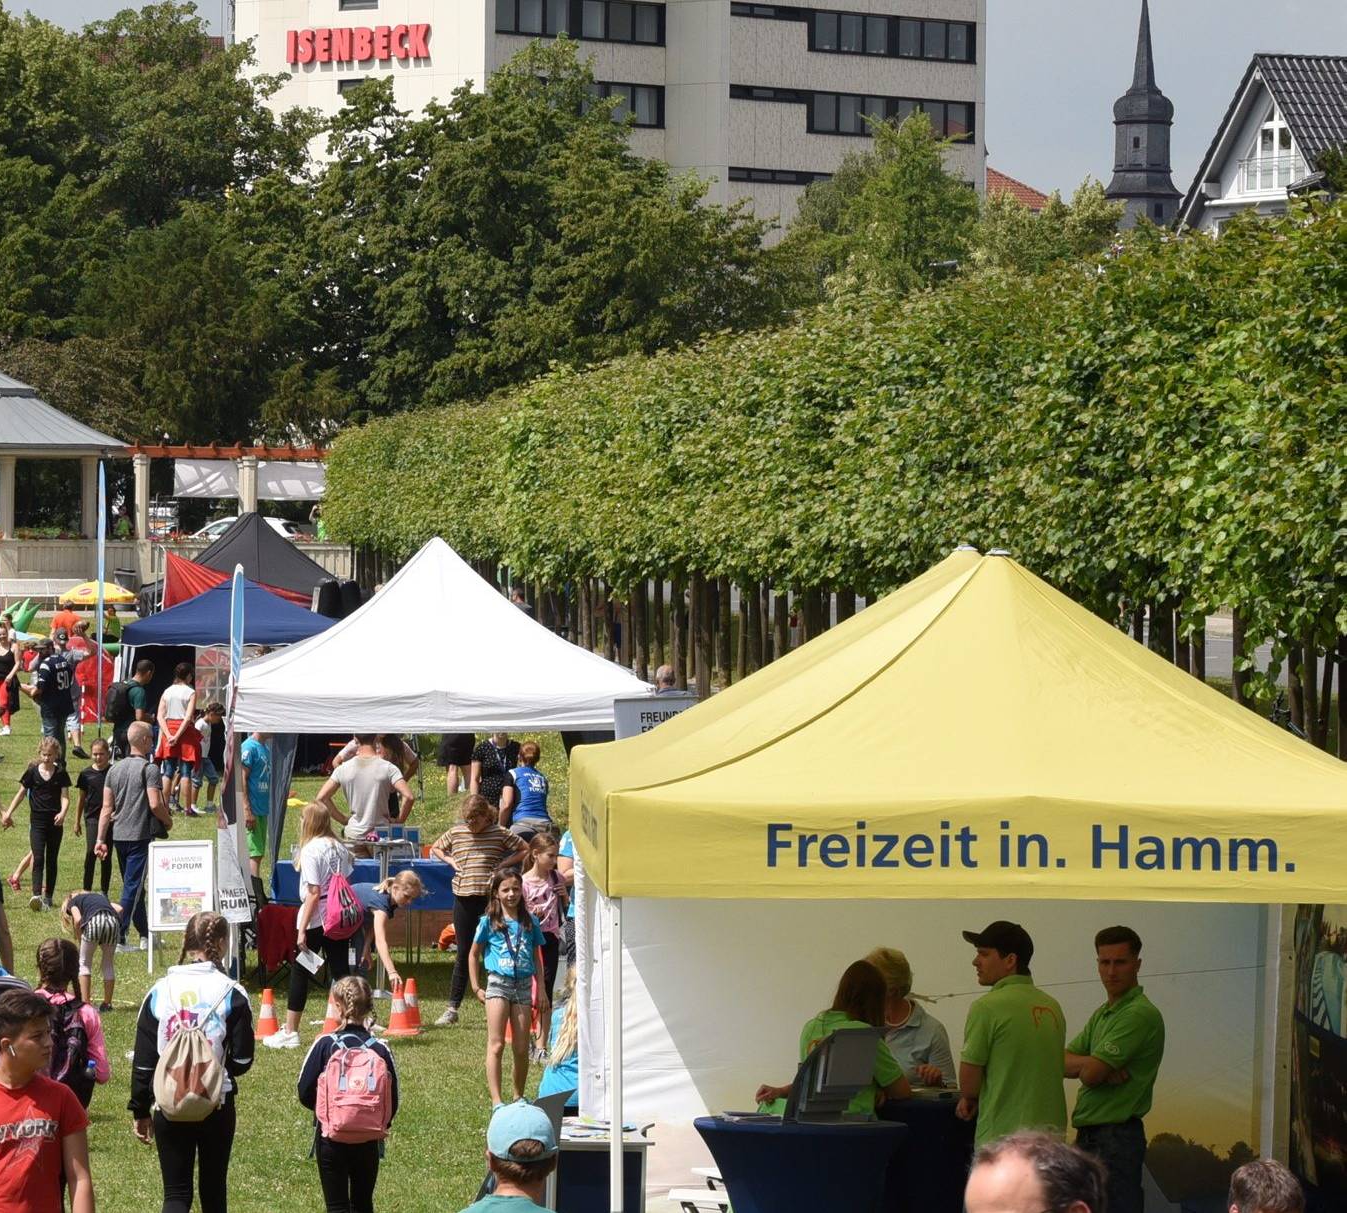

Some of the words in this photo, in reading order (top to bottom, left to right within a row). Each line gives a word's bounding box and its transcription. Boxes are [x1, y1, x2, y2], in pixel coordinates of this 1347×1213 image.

[286, 23, 432, 64] ISENBECK
[640, 711, 682, 723] FREUN
[766, 821, 978, 868] Freizeit
[999, 820, 1066, 868] in.
[1091, 824, 1296, 873] Hamm.
[171, 862, 203, 870] FORUM
[220, 898, 249, 910] RUM
